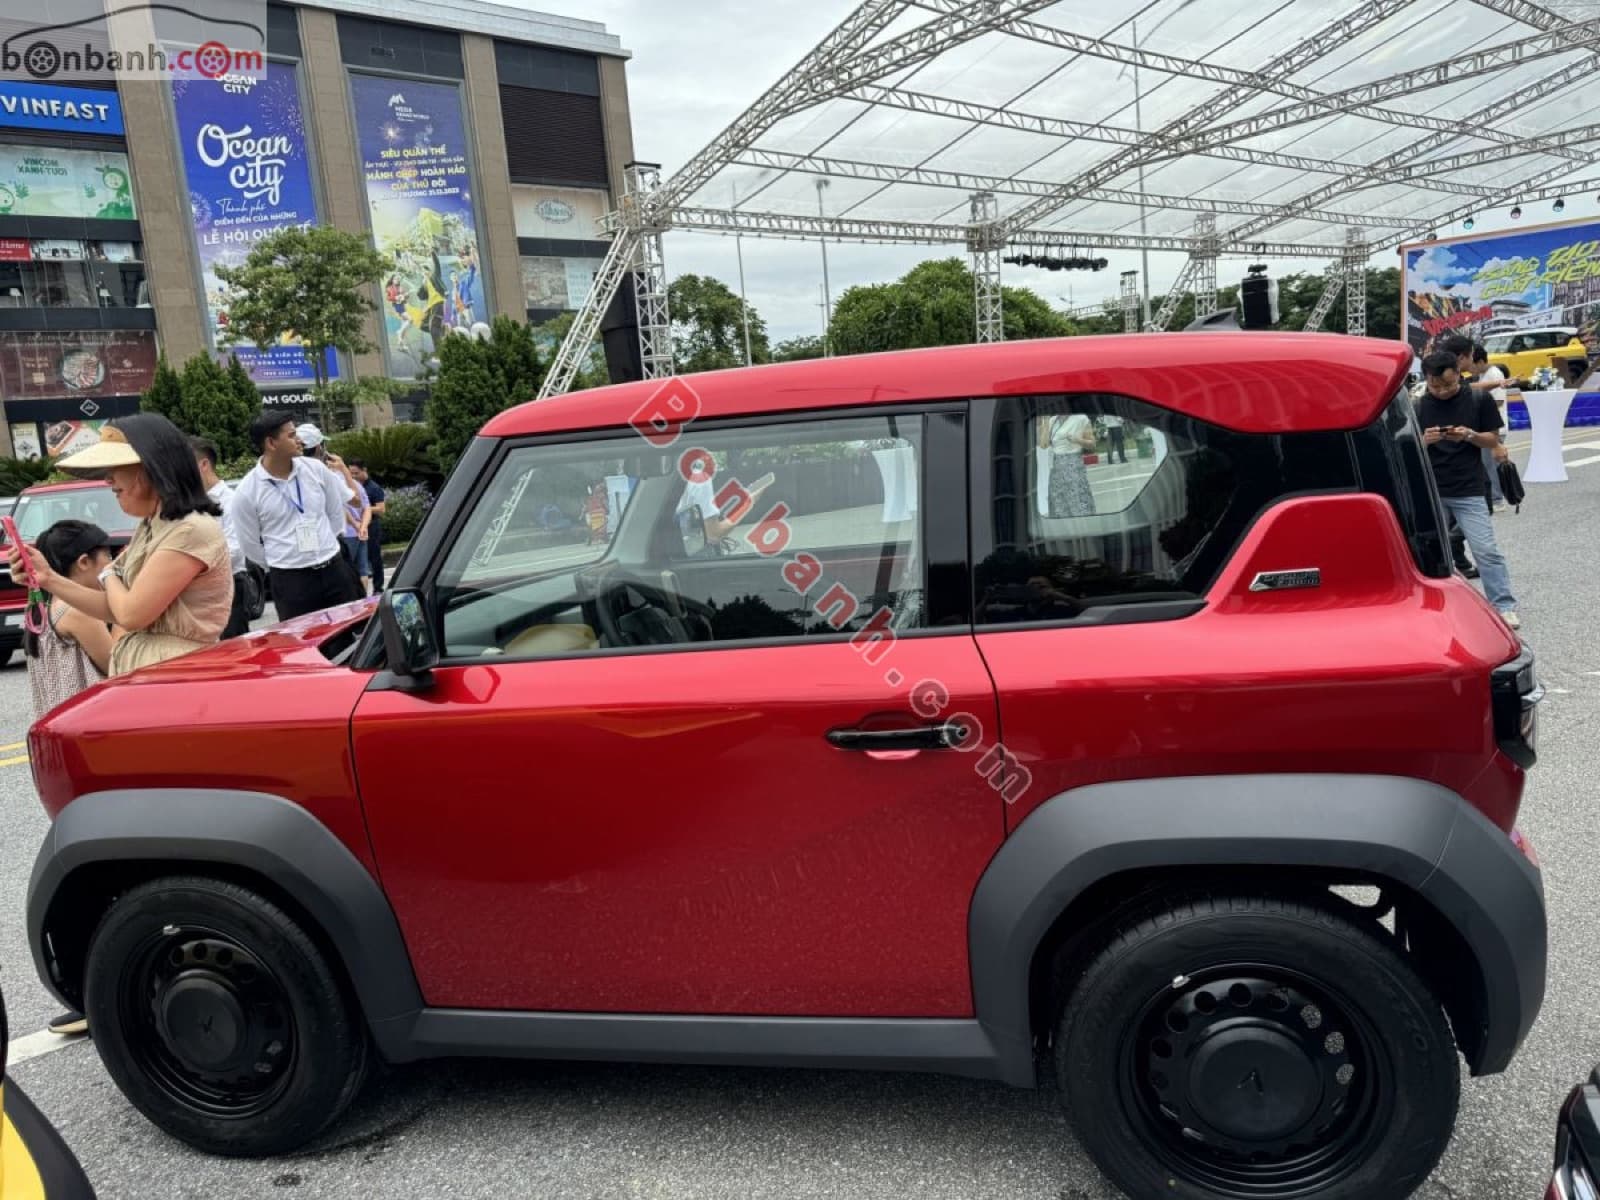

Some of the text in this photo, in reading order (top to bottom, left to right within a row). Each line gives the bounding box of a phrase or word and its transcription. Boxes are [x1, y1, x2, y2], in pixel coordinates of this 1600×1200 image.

[215, 73, 257, 86] OCEAN
[223, 83, 251, 95] CITY
[3, 96, 109, 121] VINFAST
[197, 123, 292, 167] Ocean
[229, 155, 287, 205] city
[203, 227, 220, 245] LỄ
